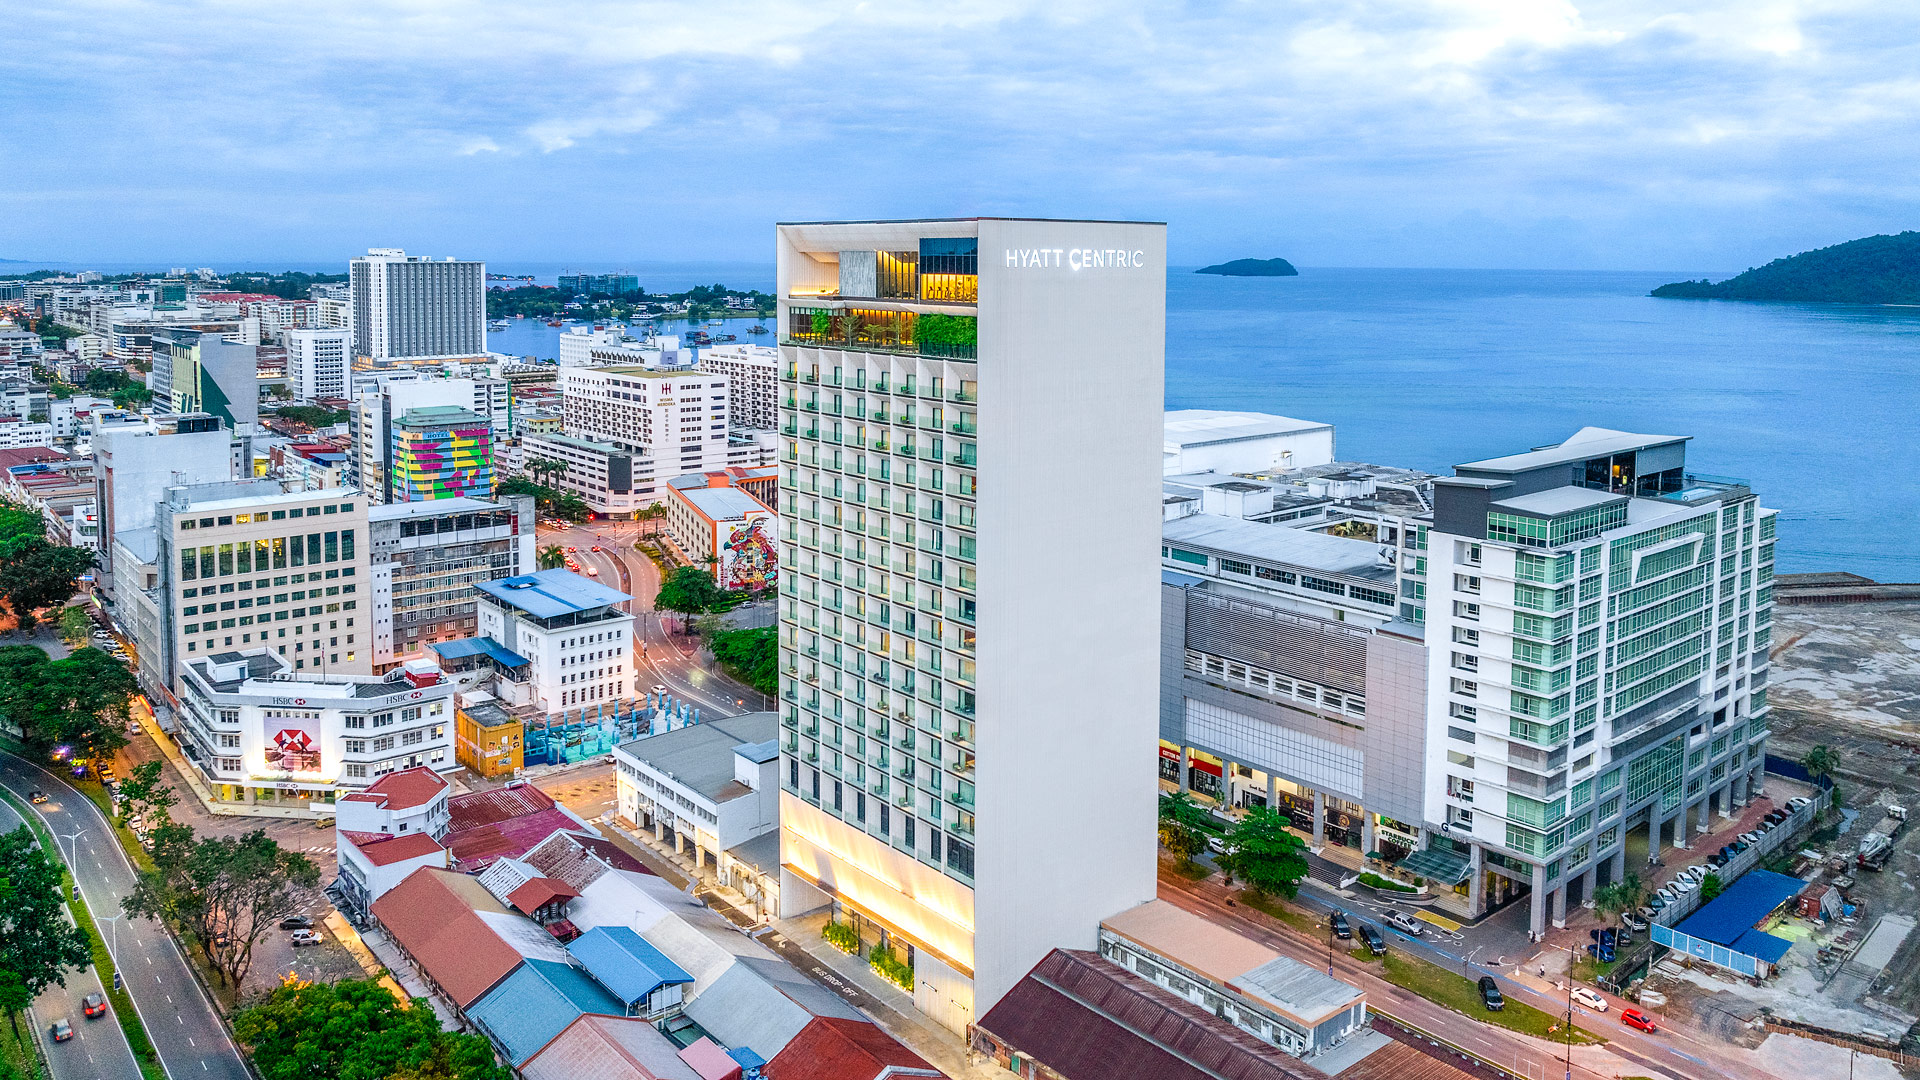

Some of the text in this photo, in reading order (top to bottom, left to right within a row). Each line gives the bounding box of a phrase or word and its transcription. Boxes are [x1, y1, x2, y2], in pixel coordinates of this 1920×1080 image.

[1005, 248, 1145, 272] HYATT CENTRIC
[272, 697, 294, 705] HSBC
[386, 693, 409, 705] HSBC
[1441, 822, 1450, 833] G
[812, 967, 827, 976] BUS
